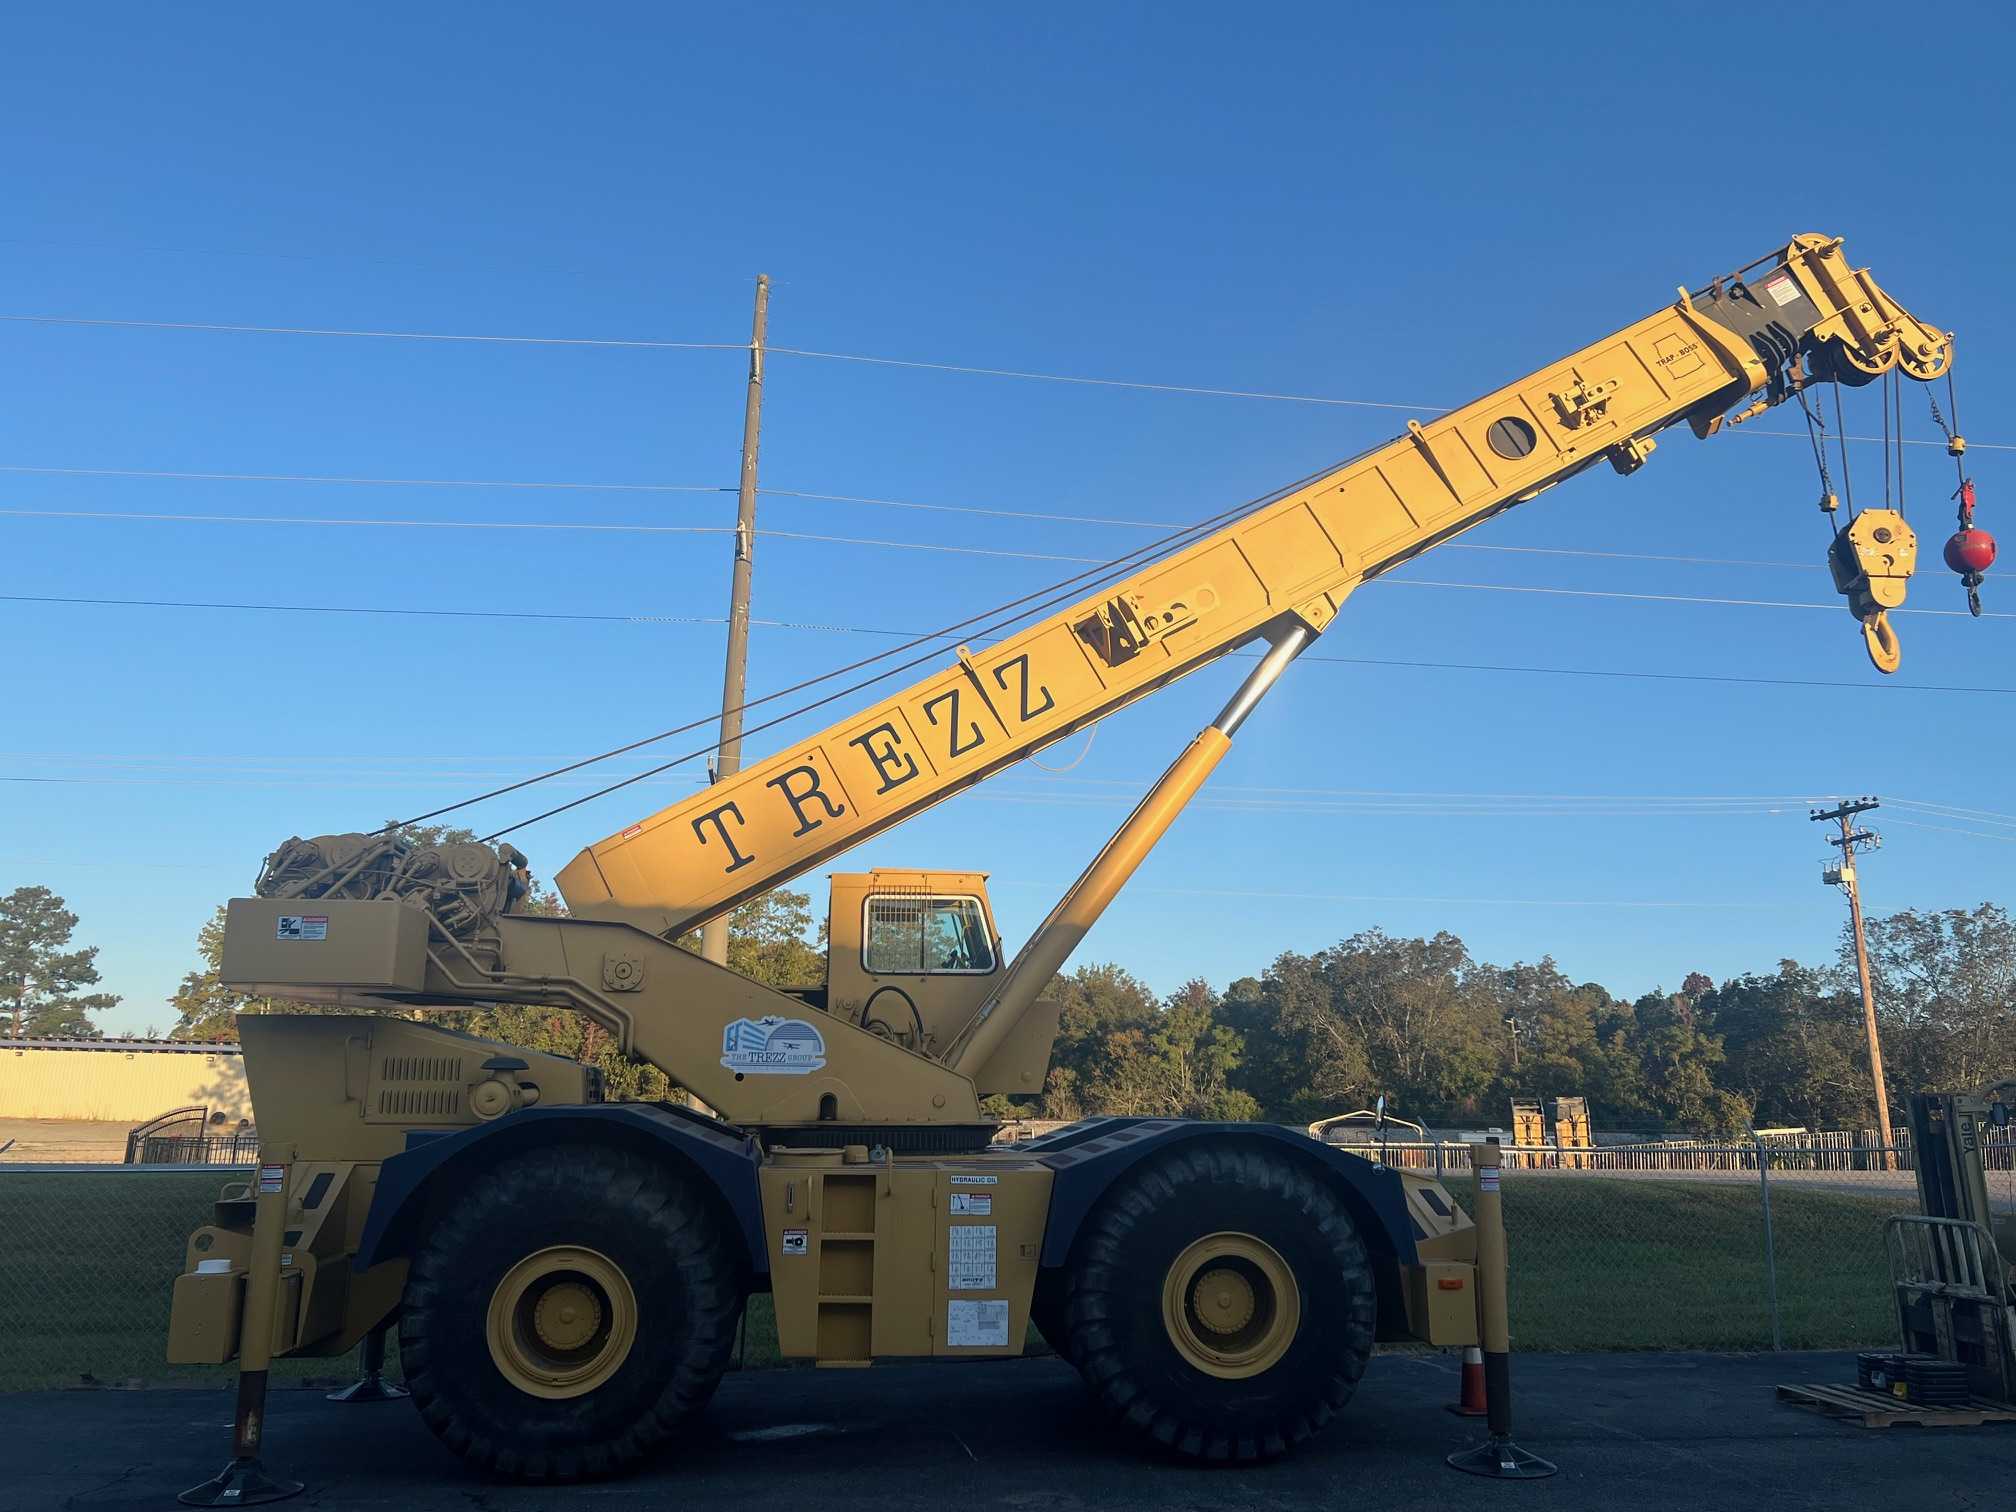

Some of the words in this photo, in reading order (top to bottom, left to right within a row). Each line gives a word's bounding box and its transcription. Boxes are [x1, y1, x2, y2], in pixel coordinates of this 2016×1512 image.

[1656, 354, 1674, 366] TRAP
[1679, 343, 1698, 356] BOSS
[691, 653, 1055, 873] TREZZ
[748, 1051, 786, 1062] TREZZ
[1961, 1122, 1974, 1153] Yale
